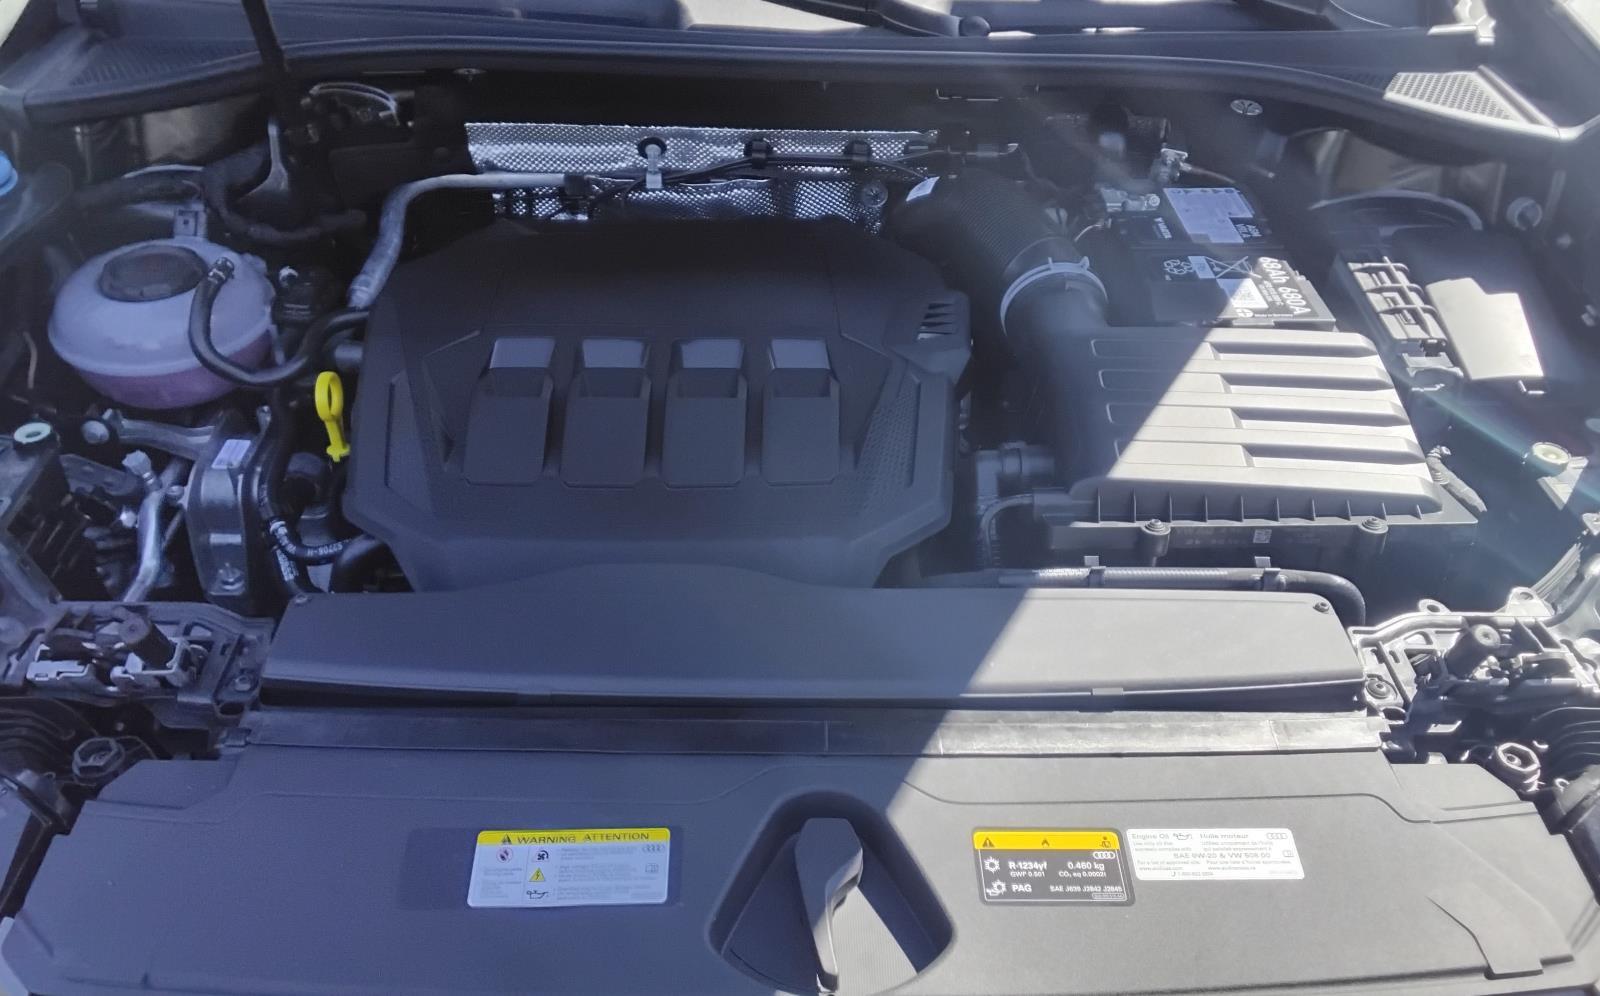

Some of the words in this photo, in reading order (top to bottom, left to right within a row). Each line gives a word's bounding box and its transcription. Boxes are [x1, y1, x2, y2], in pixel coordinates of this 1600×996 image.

[1258, 256, 1290, 284] 68Ah
[1278, 286, 1312, 315] 680A
[517, 835, 576, 844] WARNING
[583, 832, 649, 841] ATTENTION
[1008, 861, 1047, 871] R-1234yf
[1093, 861, 1105, 871] kg
[1011, 883, 1032, 892] PAG
